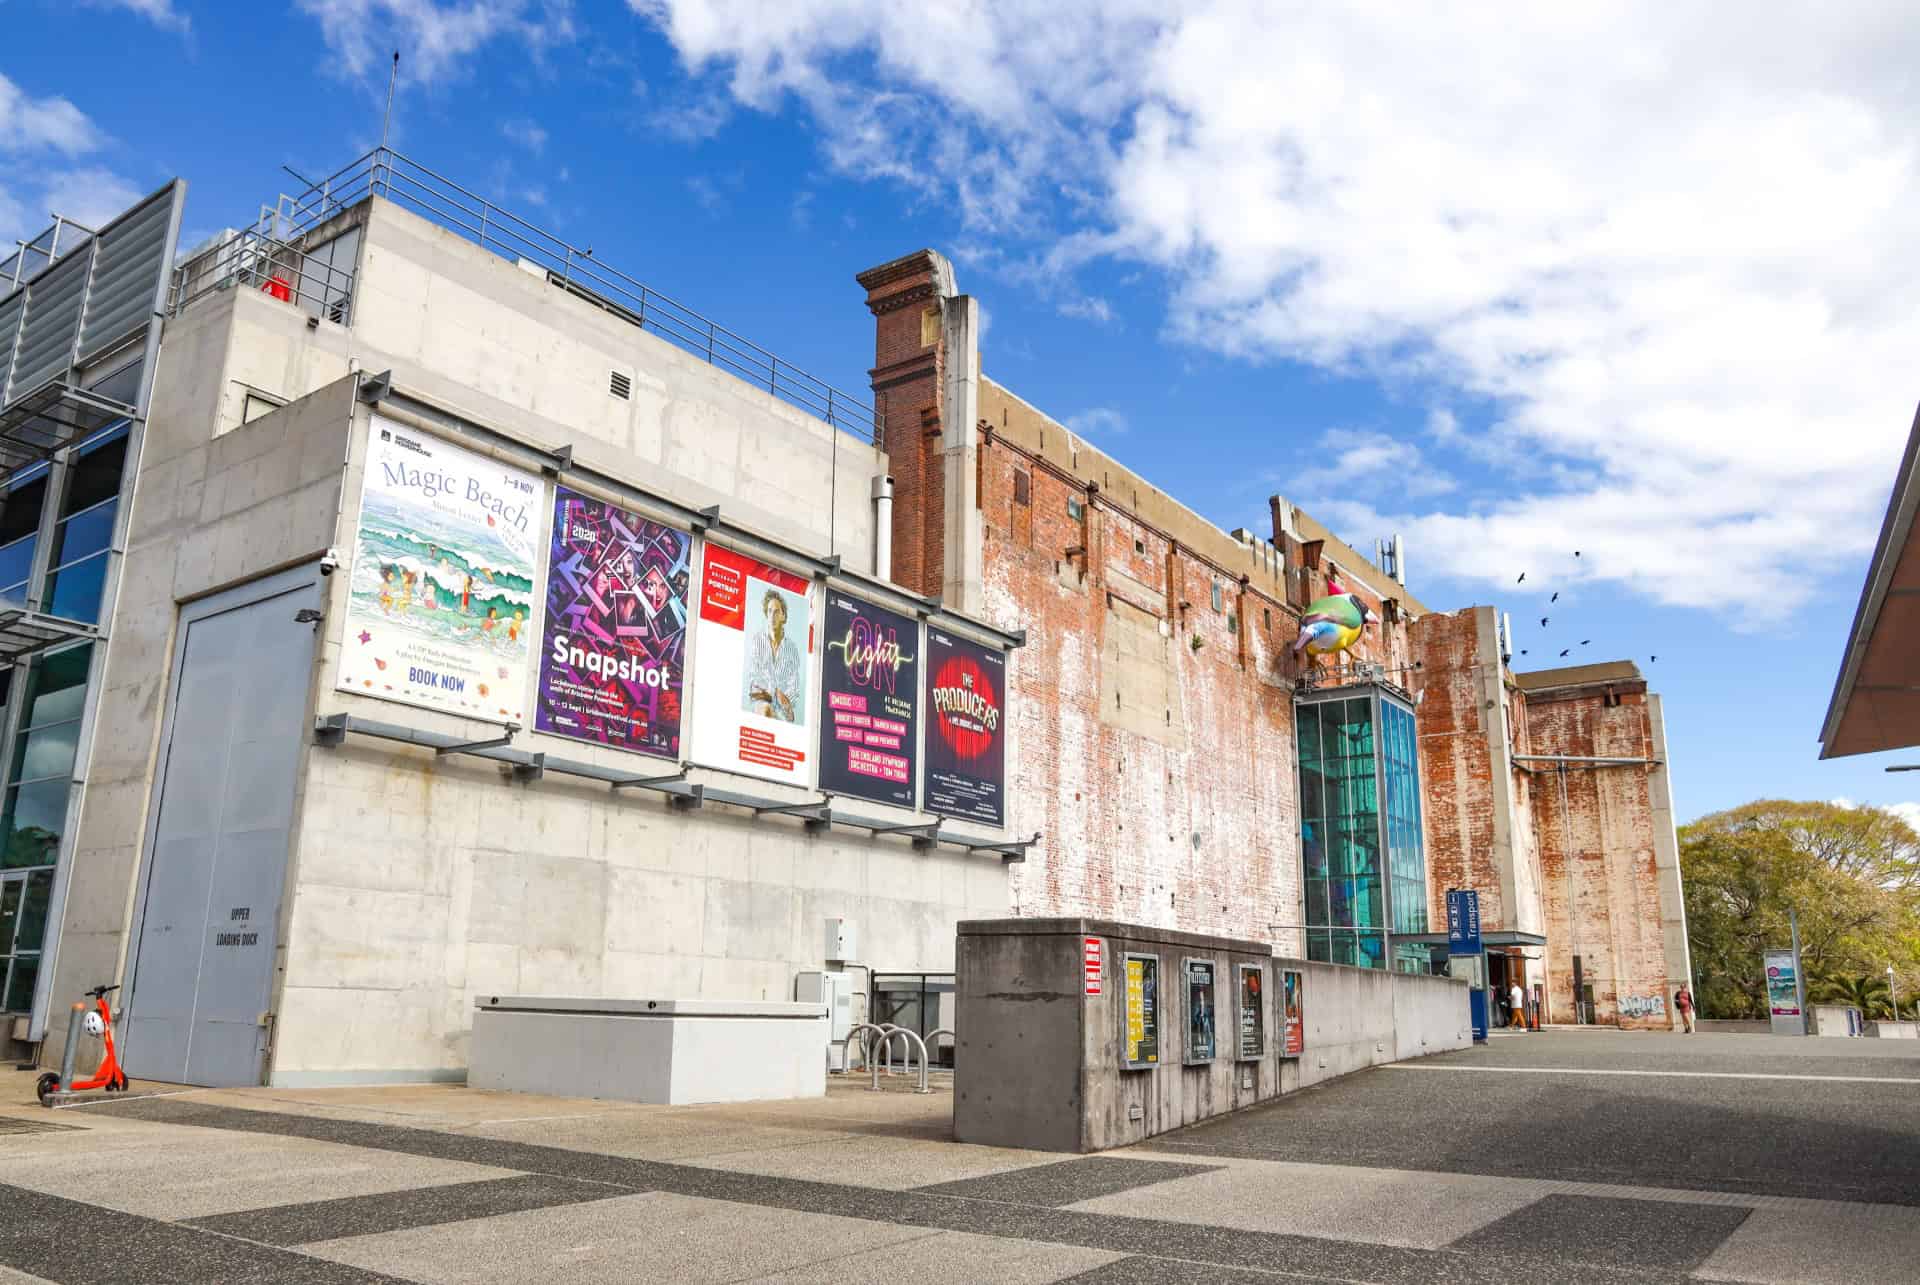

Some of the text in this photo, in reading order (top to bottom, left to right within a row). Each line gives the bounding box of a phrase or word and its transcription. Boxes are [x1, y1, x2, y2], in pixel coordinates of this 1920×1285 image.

[520, 481, 535, 495] NOV
[381, 462, 456, 498] Magic
[465, 477, 529, 533] Beach
[572, 525, 596, 542] 2020
[708, 579, 739, 595] PORTRAIT
[551, 635, 670, 690] Snapshot
[409, 666, 438, 688] BOOK
[441, 673, 465, 693] NOW
[962, 672, 974, 688] THE
[933, 687, 1000, 731] PRODUCERS
[231, 907, 250, 920] UPPER
[1467, 892, 1478, 939] Transport
[216, 932, 258, 946] LOADING DOCK
